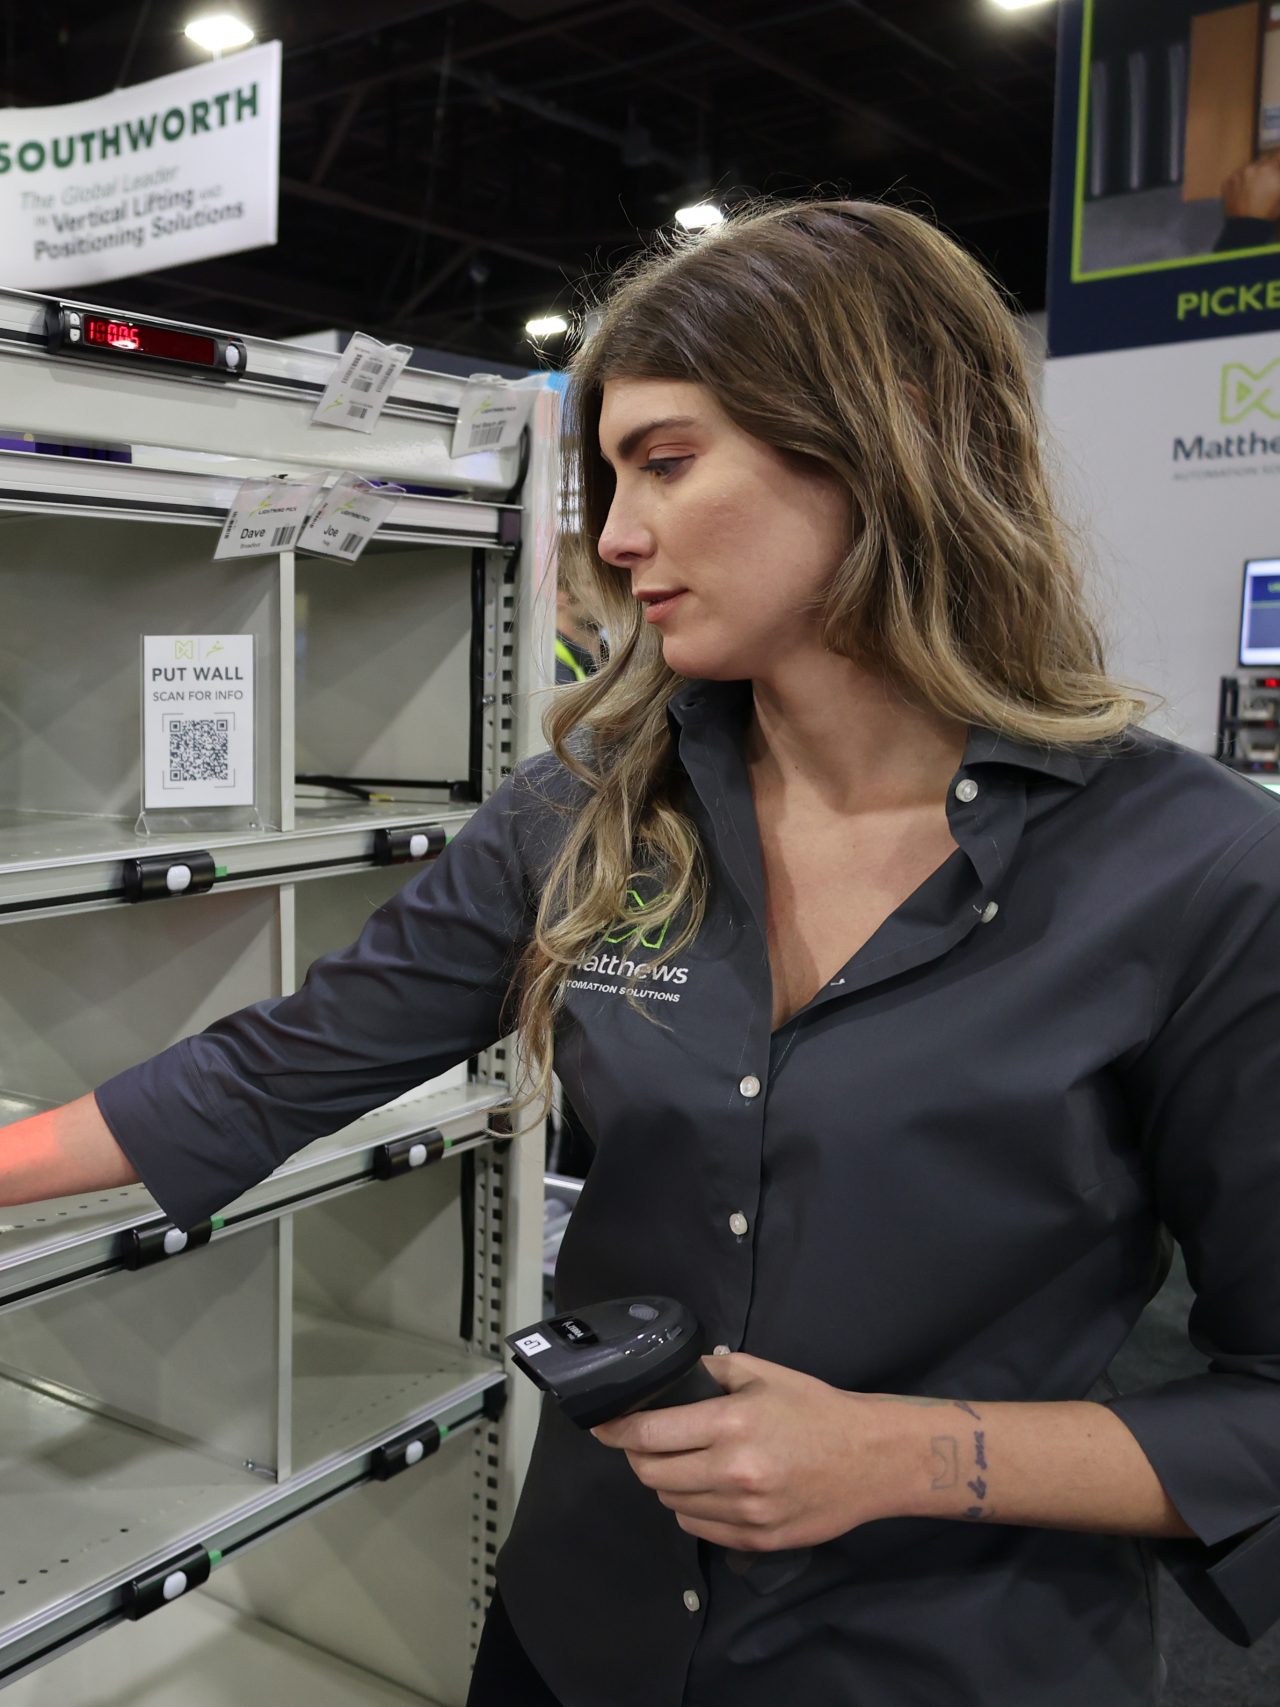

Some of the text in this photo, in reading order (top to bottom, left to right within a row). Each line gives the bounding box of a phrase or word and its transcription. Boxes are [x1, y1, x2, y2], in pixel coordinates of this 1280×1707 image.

[19, 166, 180, 210] The Global Leader
[52, 201, 128, 233] Vertical
[132, 187, 195, 217] Lifting
[34, 202, 244, 261] Positioning Solutions
[1177, 279, 1280, 321] PICKE
[240, 527, 266, 539] Dave
[323, 524, 339, 537] Joe
[152, 666, 244, 682] PUT WALL
[153, 690, 244, 702] SCAN FOR INFO
[577, 952, 689, 985] atthews
[619, 987, 681, 1003] SOLUTIONS
[523, 1339, 542, 1350] LP
